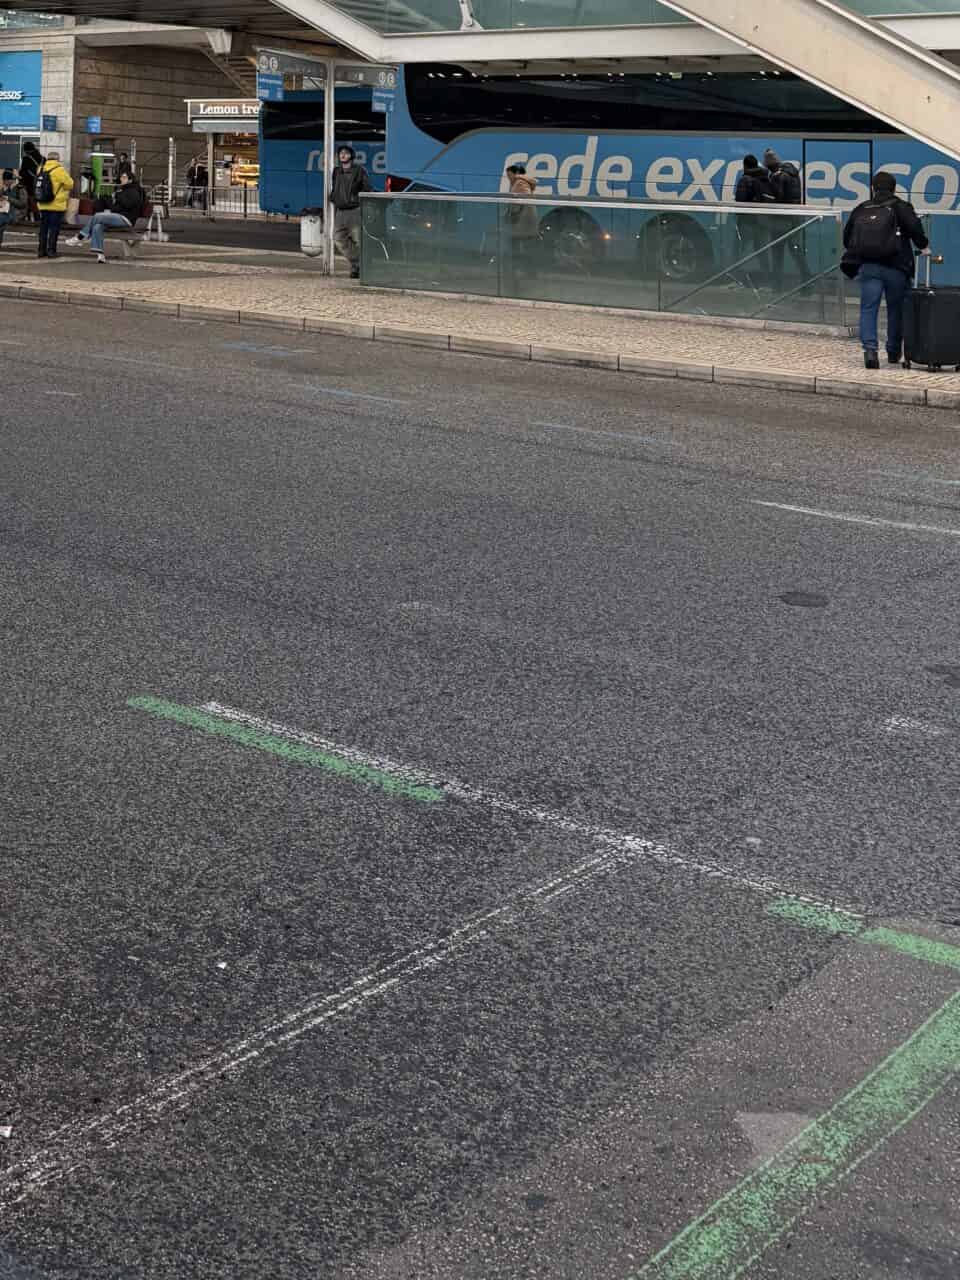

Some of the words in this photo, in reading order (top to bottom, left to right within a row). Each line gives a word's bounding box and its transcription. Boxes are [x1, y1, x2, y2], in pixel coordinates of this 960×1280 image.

[200, 104, 239, 114] Lemon
[242, 103, 259, 114] tre
[499, 135, 632, 200] rede
